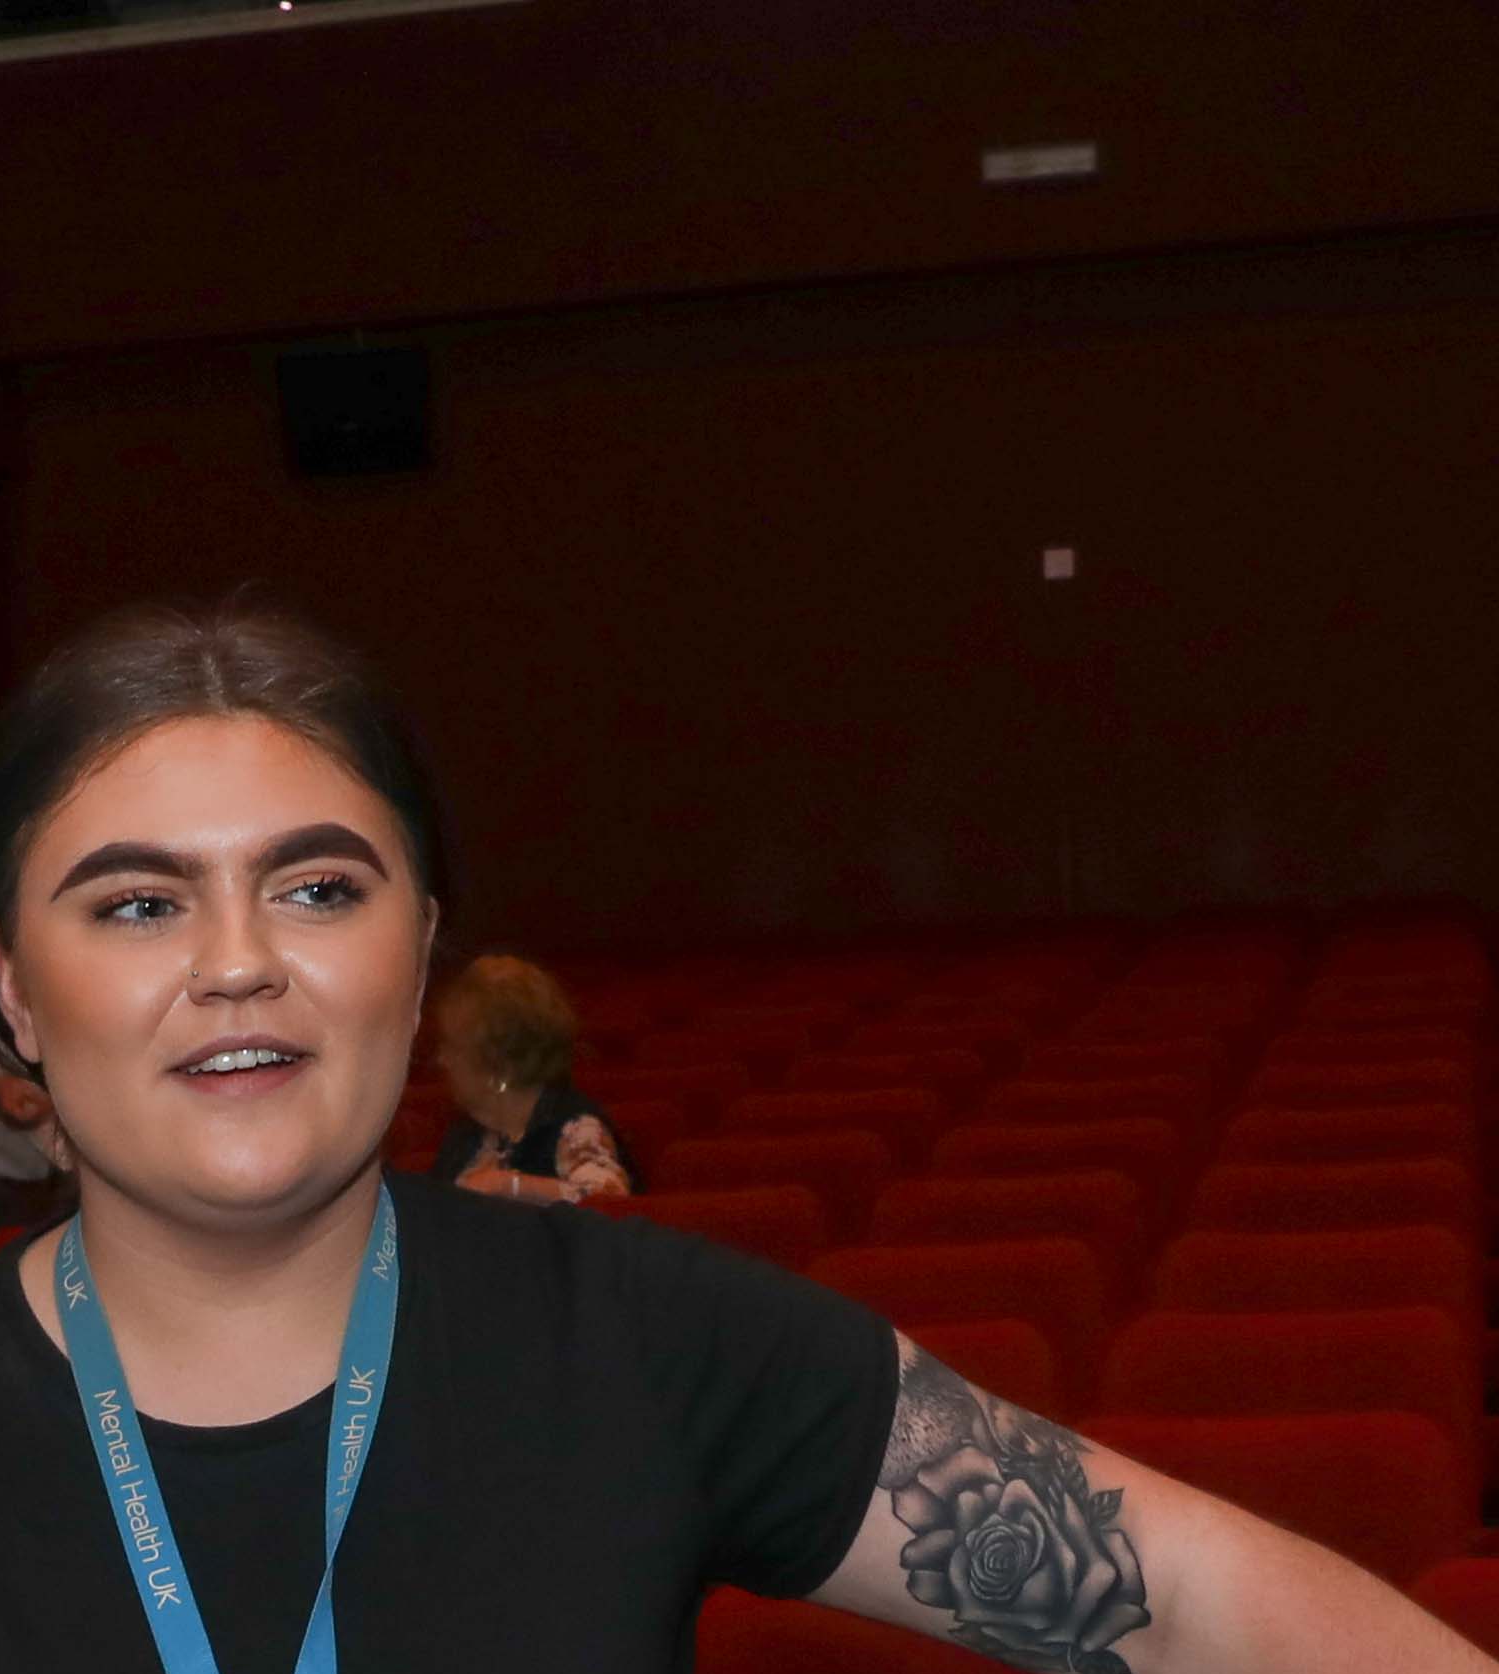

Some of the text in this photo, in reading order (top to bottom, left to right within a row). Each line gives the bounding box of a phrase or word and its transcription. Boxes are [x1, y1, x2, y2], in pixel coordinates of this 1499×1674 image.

[64, 1266, 89, 1310] UK
[347, 1365, 376, 1405] UK
[336, 1414, 368, 1497] Health
[94, 1389, 181, 1610] Mental Health UK
